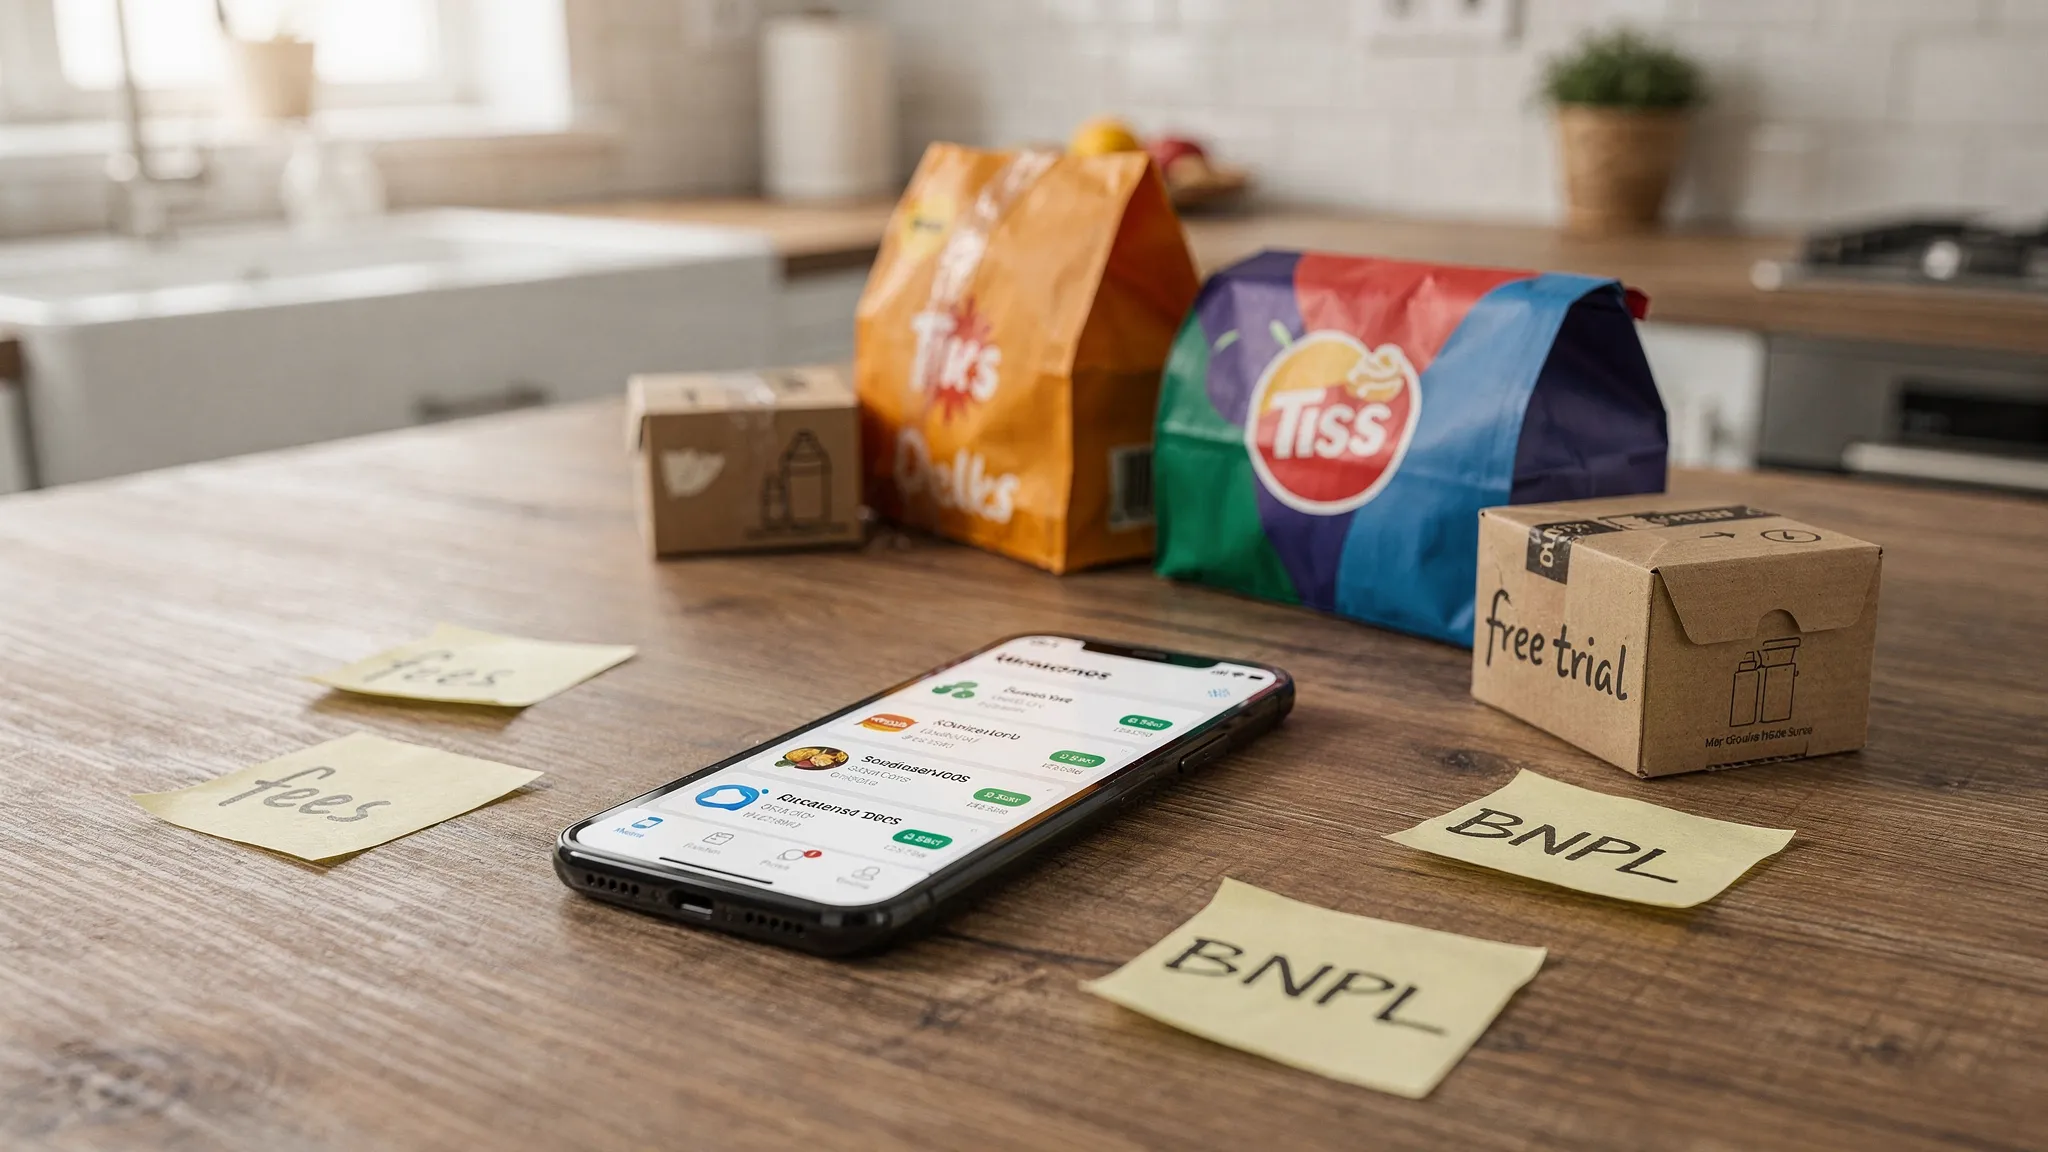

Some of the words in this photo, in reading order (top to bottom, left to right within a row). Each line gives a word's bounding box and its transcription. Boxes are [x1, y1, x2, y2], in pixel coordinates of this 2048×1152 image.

[363, 649, 515, 688] fees
[1486, 589, 1545, 667] free
[1552, 624, 1628, 701] trial
[218, 765, 391, 823] fees
[1445, 807, 1679, 884] BNPL
[1164, 936, 1449, 1037] BNPL
